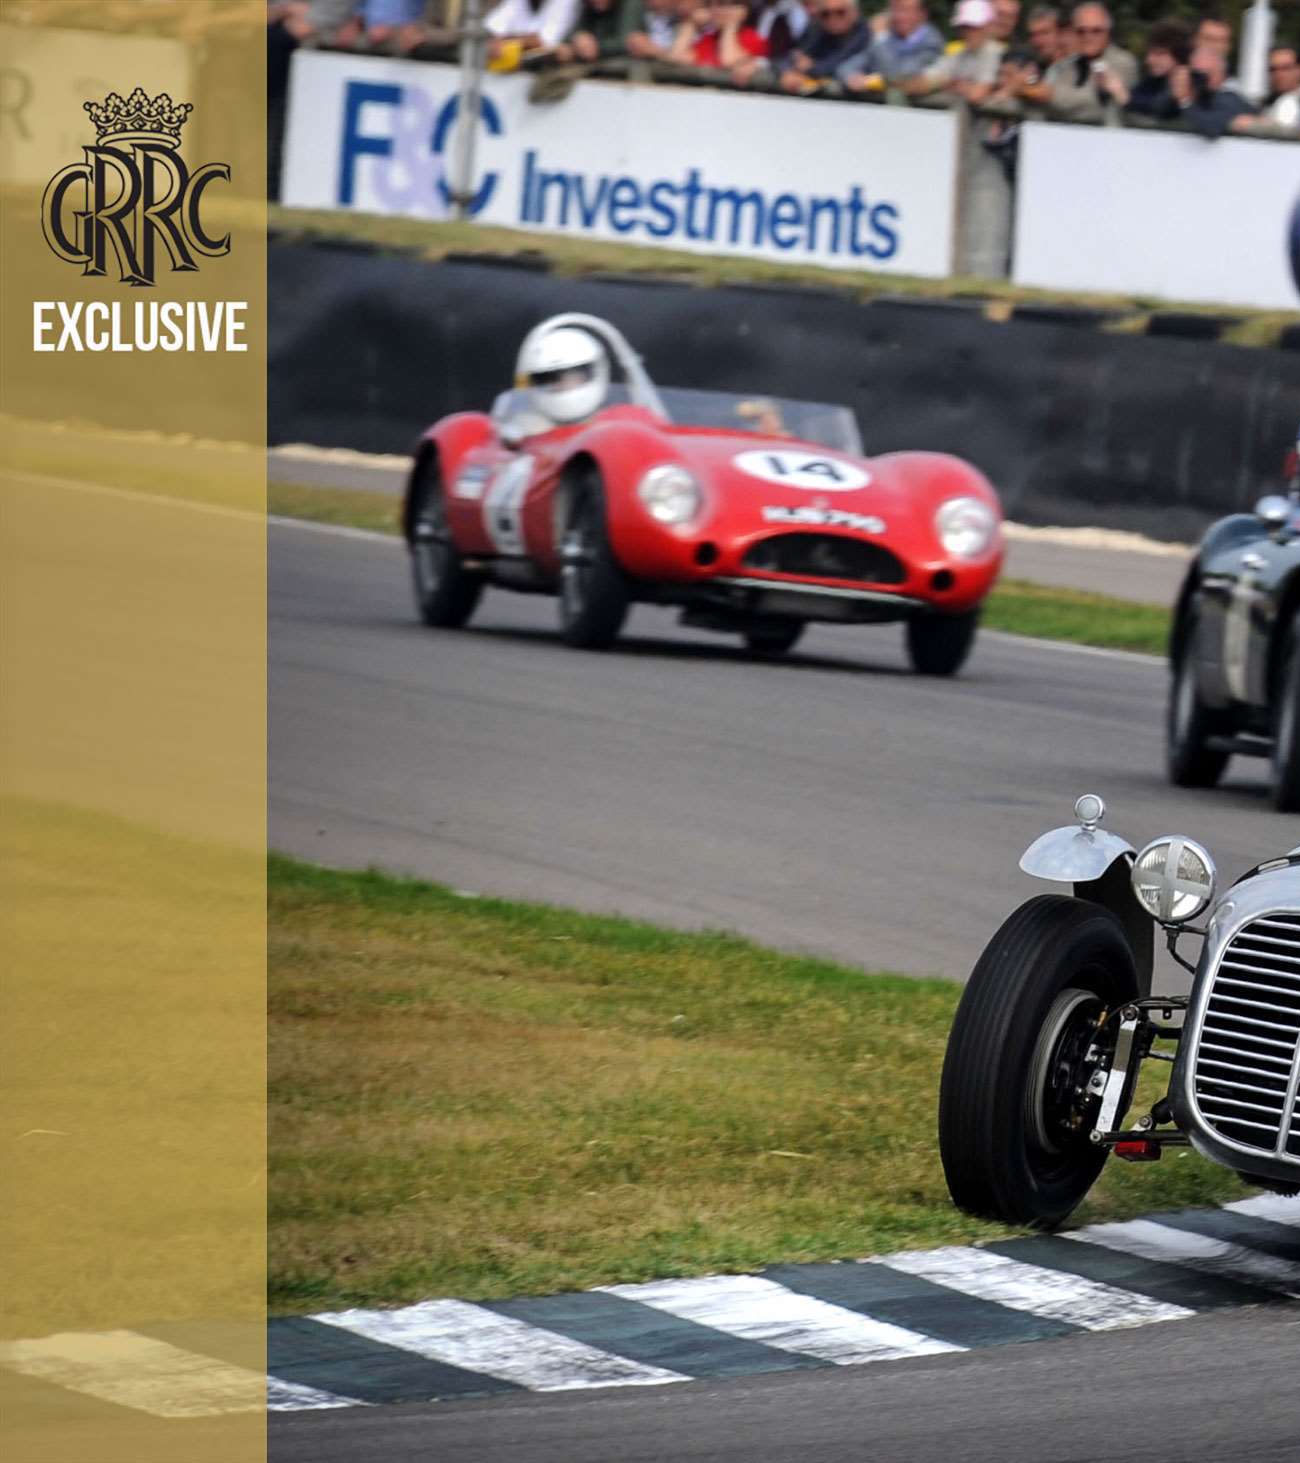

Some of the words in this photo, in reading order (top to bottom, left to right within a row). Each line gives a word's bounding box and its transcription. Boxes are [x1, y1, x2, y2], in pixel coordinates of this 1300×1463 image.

[337, 80, 503, 219] F&C
[519, 150, 901, 260] Investments
[767, 456, 842, 480] 14
